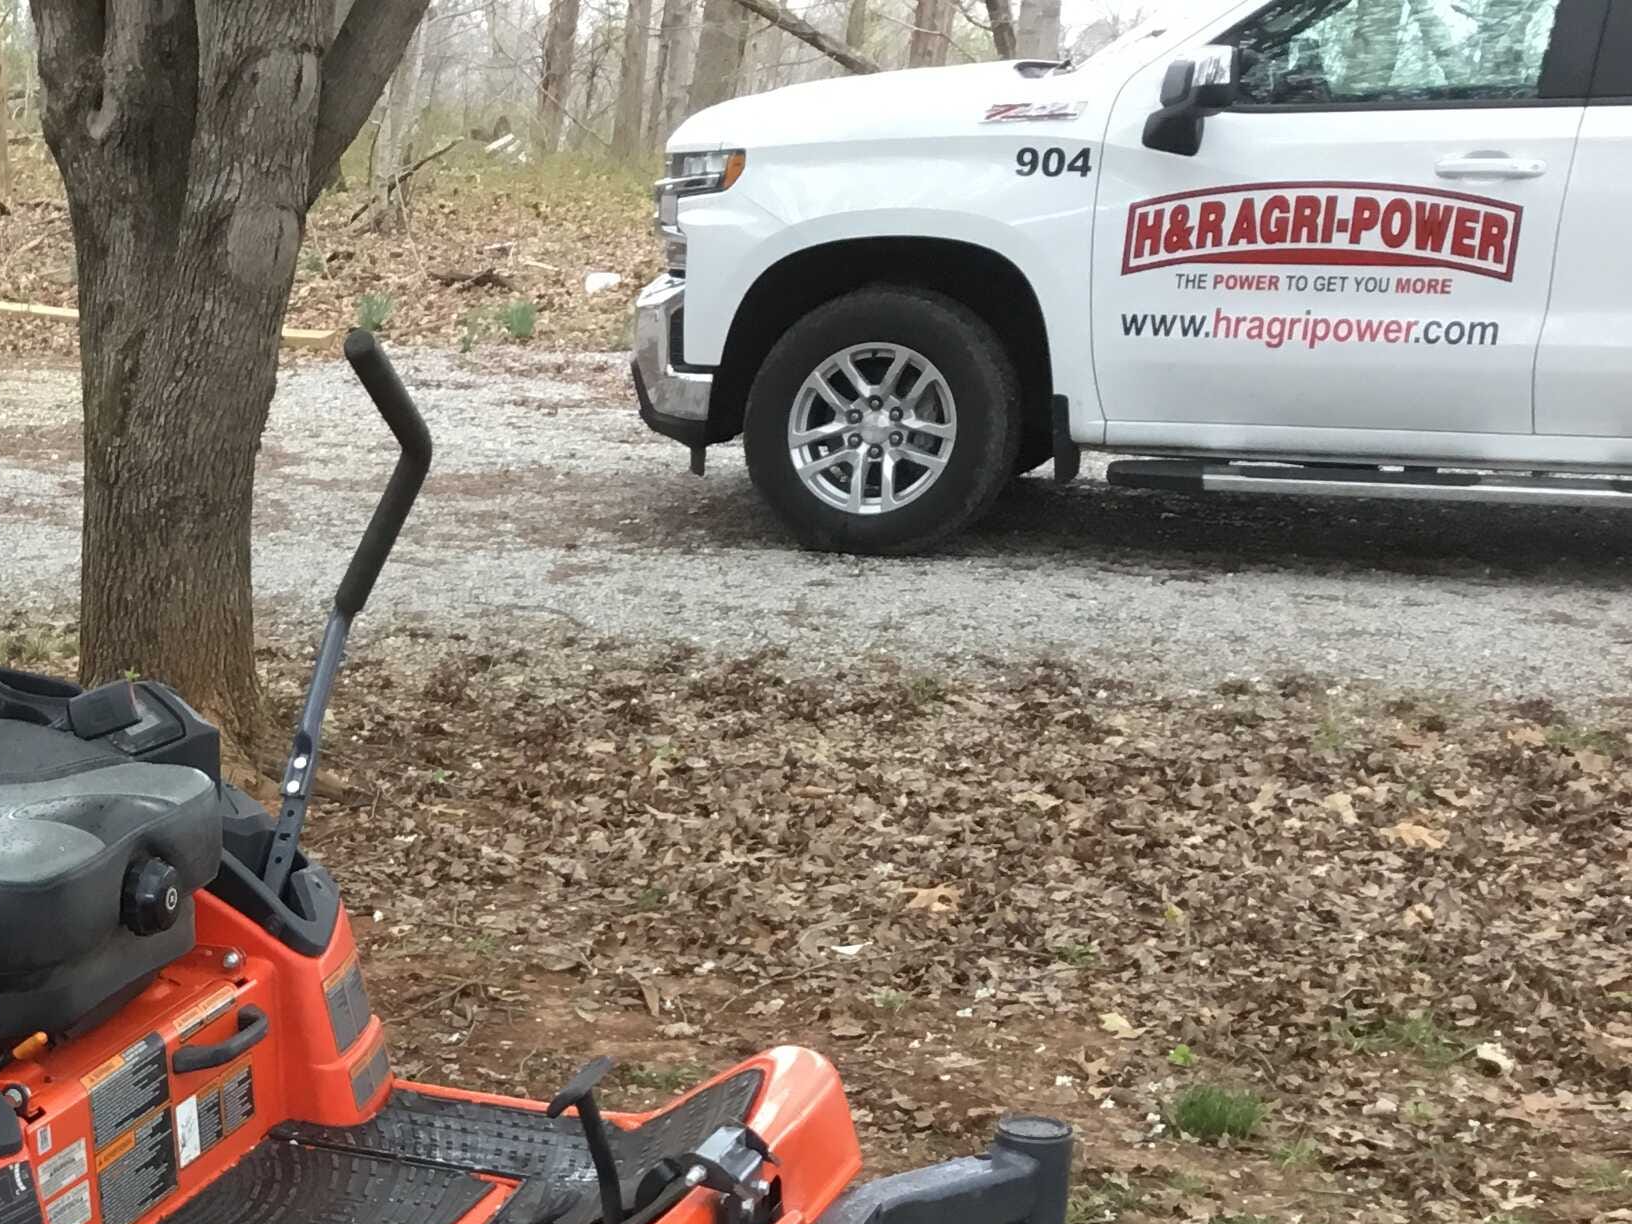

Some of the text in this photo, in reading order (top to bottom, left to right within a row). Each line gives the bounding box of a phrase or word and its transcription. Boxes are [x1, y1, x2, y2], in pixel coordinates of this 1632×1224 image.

[1016, 147, 1092, 177] 904
[1175, 273, 1454, 295] THE POWER TO GET YOU MORE
[1120, 308, 1500, 348] www.hragripower.com
